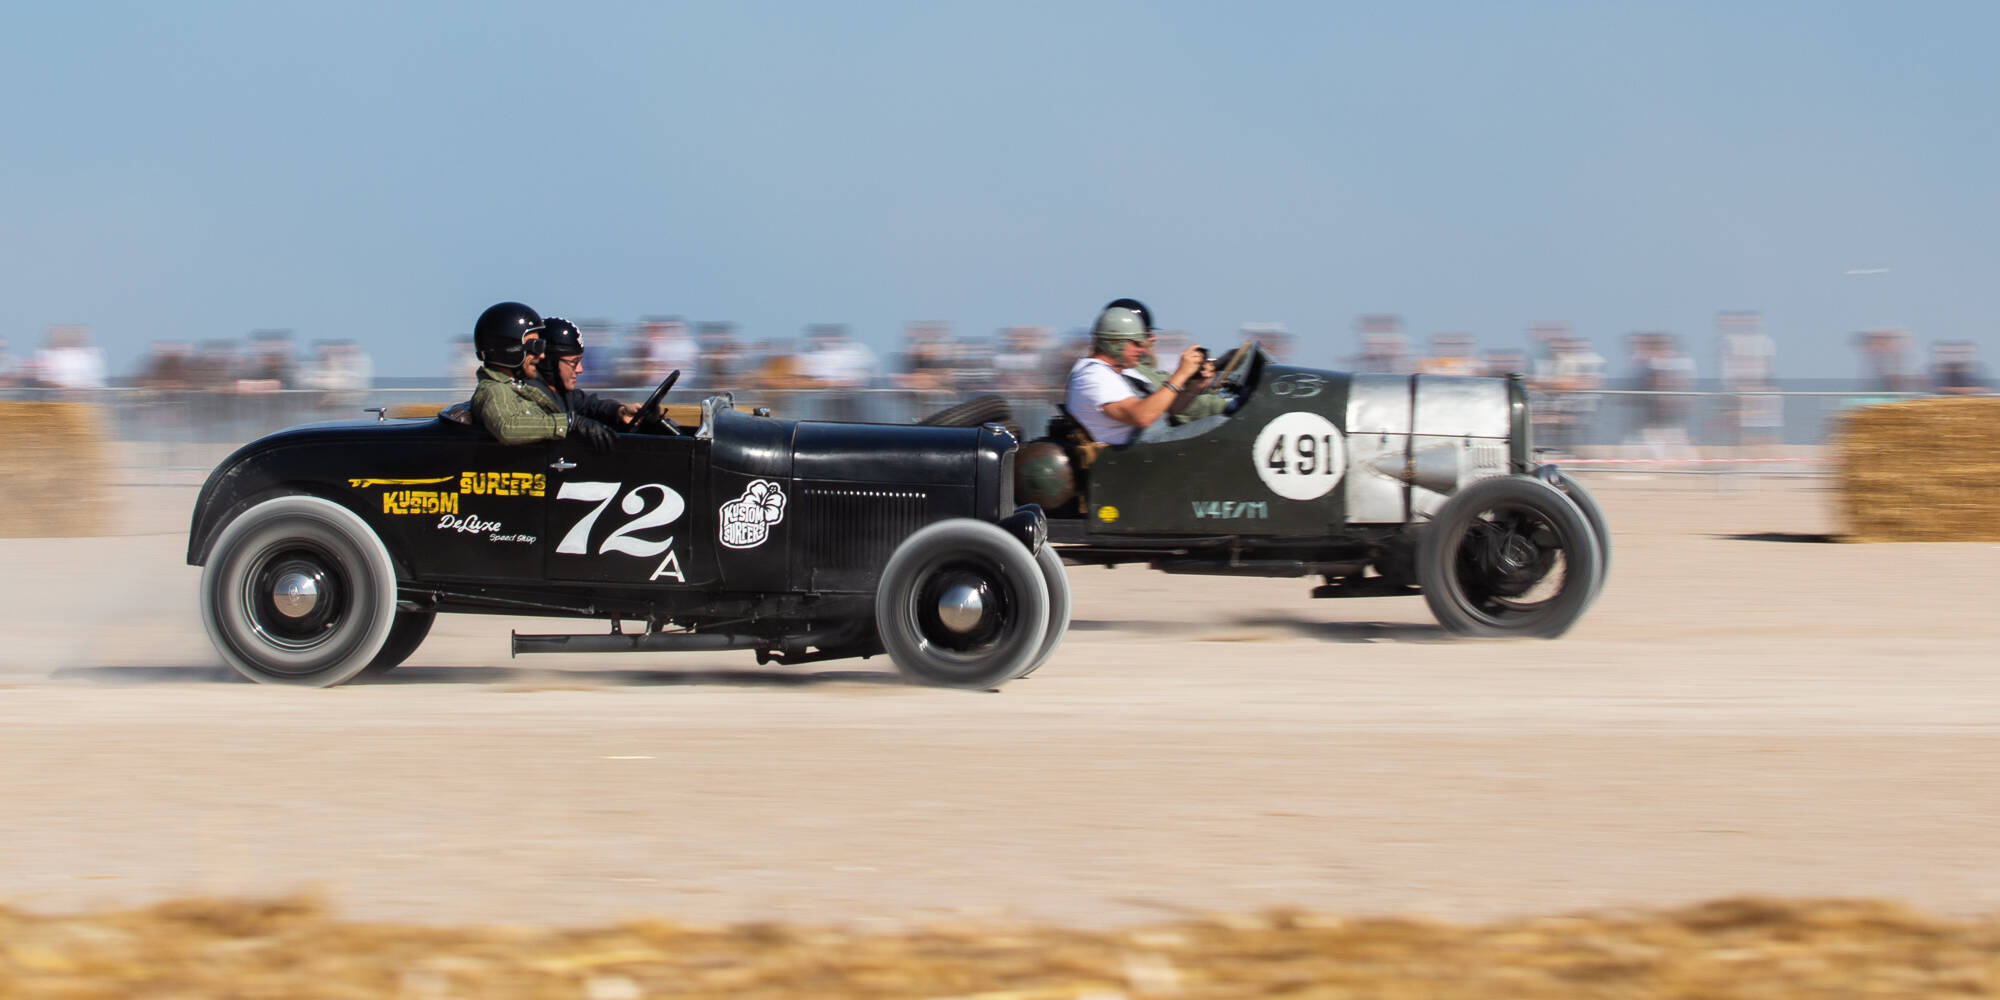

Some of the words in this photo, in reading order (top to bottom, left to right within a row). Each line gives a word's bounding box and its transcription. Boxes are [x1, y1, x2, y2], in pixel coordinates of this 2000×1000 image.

[1269, 434, 1335, 475] 491
[460, 472, 546, 497] SURFERS
[383, 490, 459, 515] KUSTOM
[723, 503, 765, 525] KUSTOM
[437, 514, 502, 534] DeLuxe
[555, 481, 685, 557] 72
[489, 533, 516, 542] Speed
[723, 520, 766, 545] SURFERS
[649, 550, 686, 583] A
